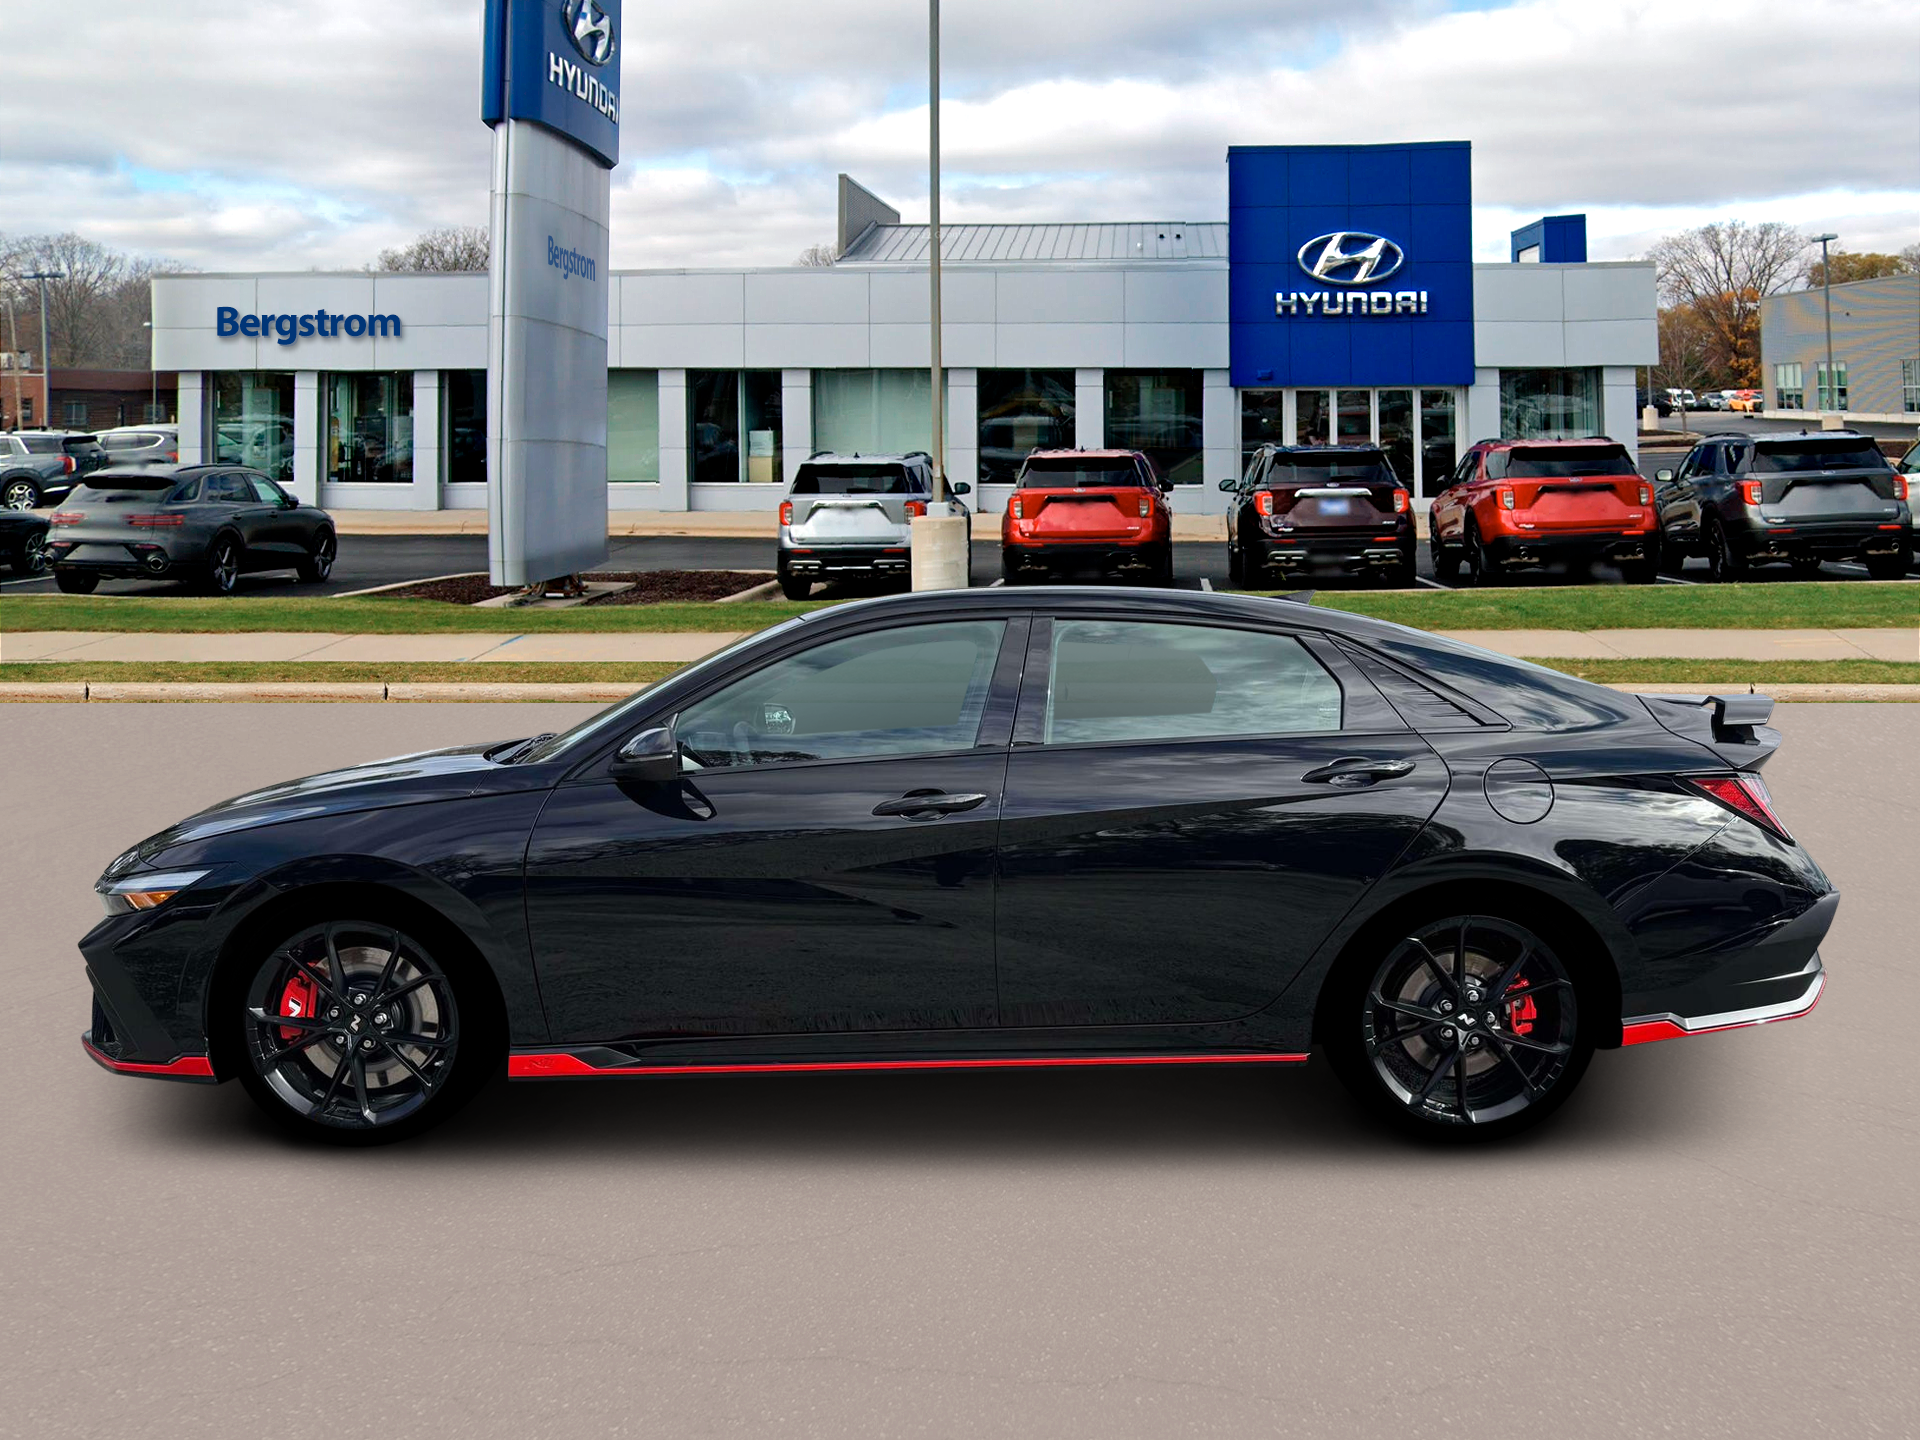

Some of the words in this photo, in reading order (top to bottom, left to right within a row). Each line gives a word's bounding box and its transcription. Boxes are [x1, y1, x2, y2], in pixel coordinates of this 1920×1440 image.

[549, 51, 619, 124] HYUNDAI
[547, 234, 596, 282] Bergstrom
[1275, 290, 1428, 315] HYUNDAI
[216, 306, 402, 346] Bergstrom
